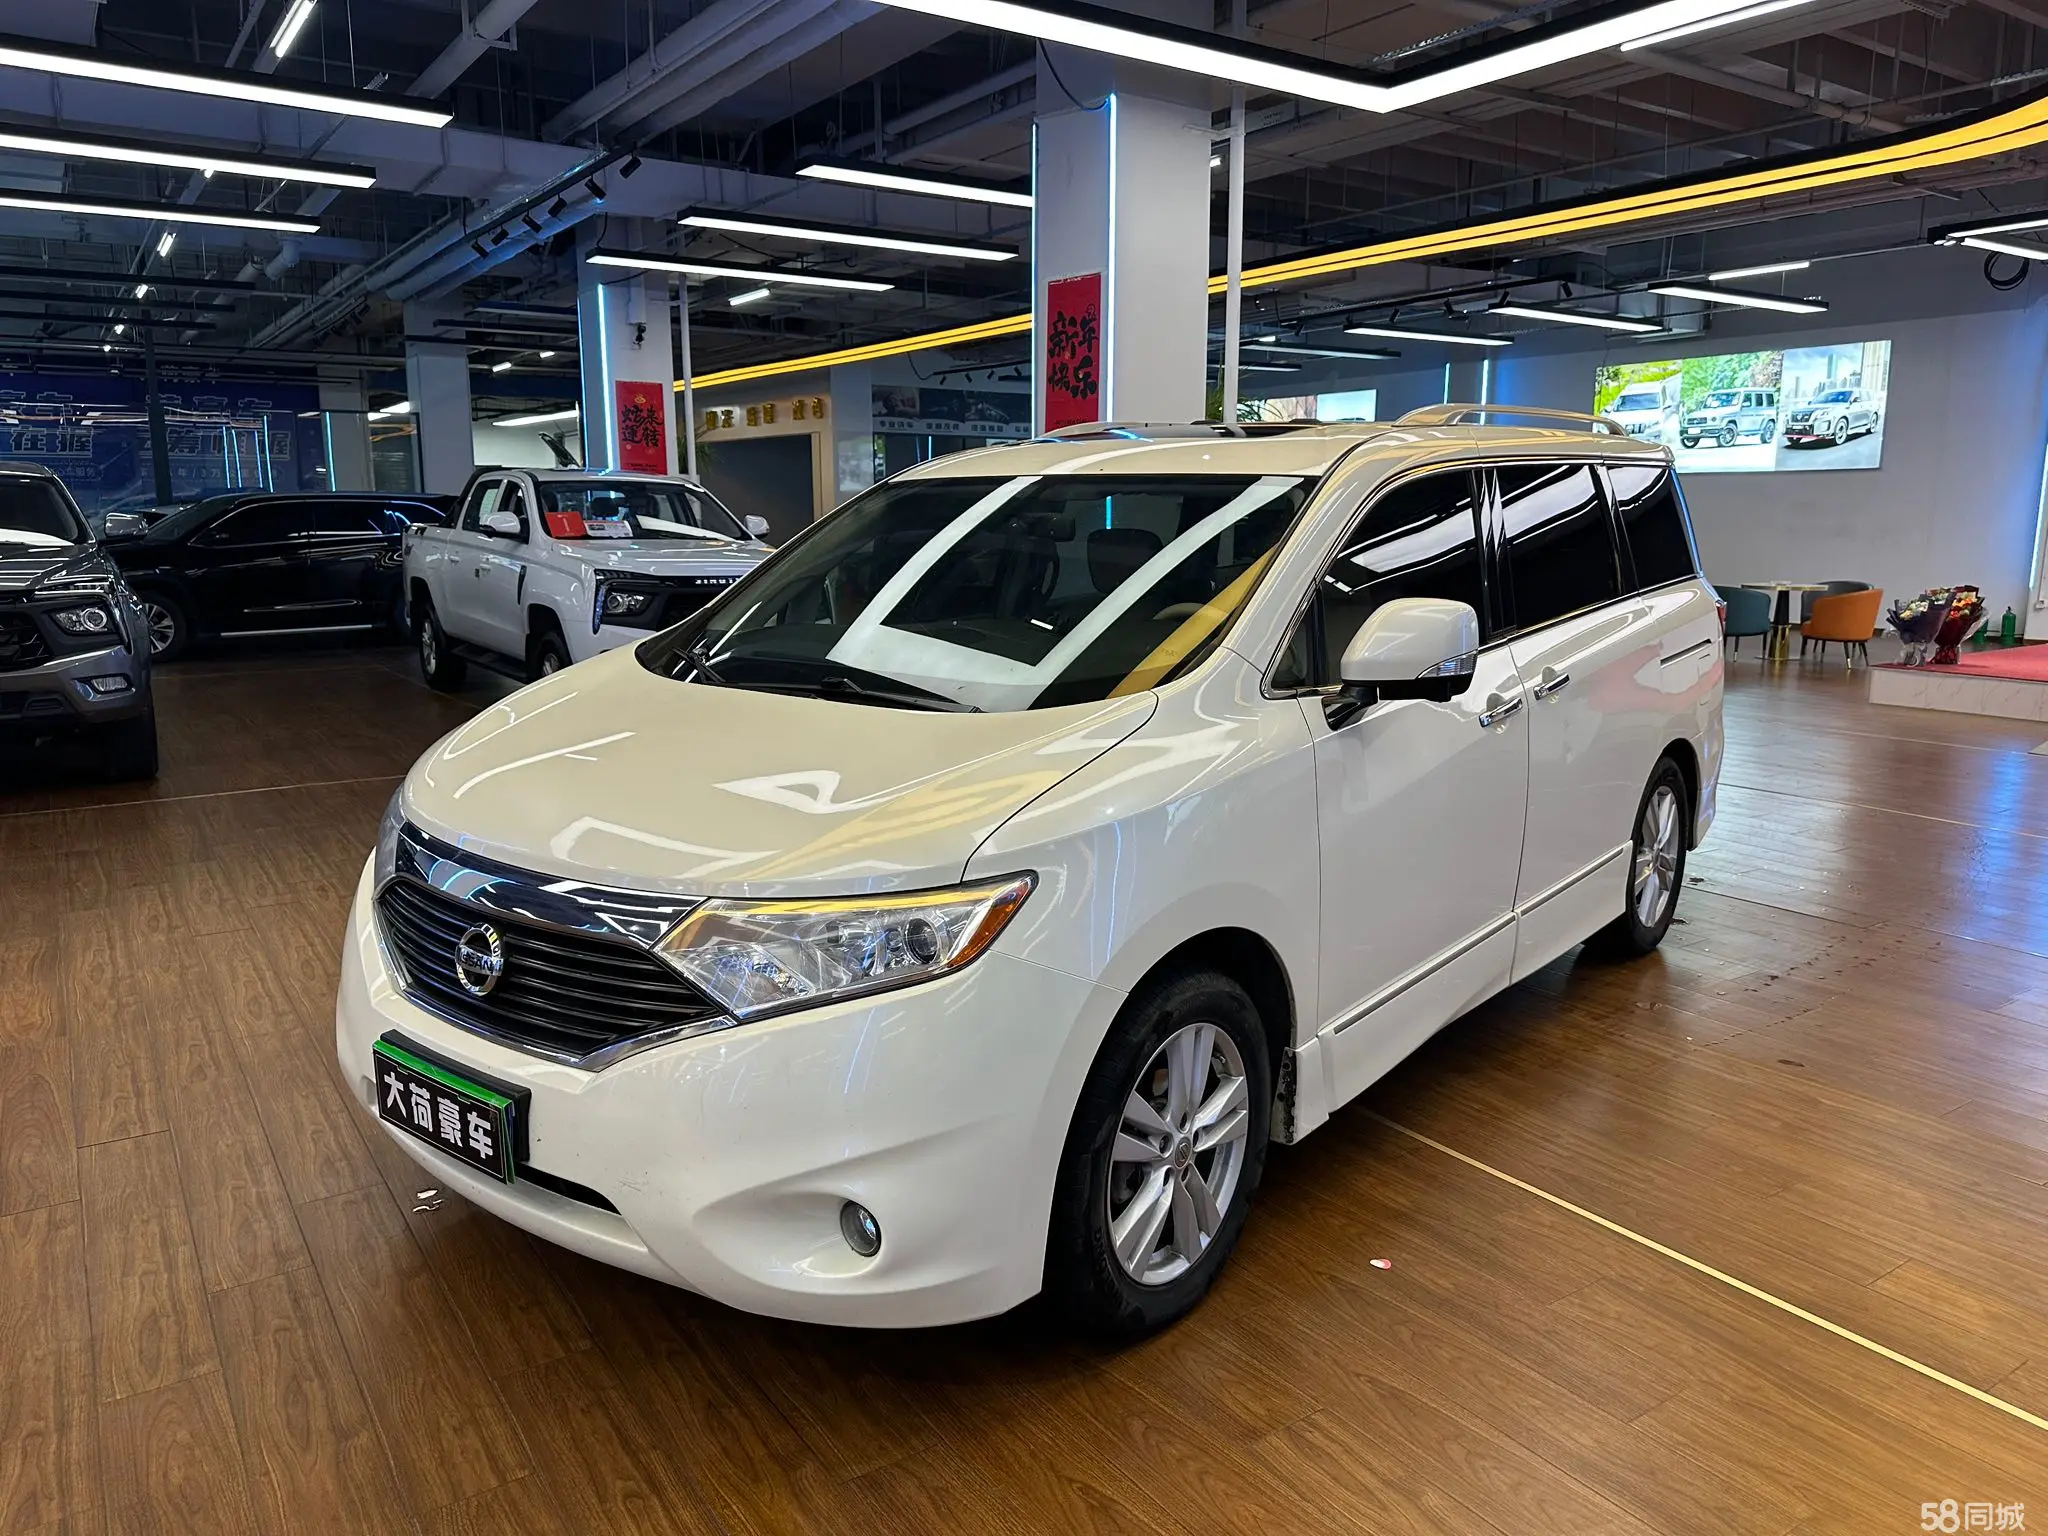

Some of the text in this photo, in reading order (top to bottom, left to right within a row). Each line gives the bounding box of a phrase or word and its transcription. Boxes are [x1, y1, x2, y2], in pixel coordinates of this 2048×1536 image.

[1048, 307, 1099, 359] 新年
[1048, 356, 1097, 400] 快乐
[384, 1071, 493, 1159] 大荷豪车
